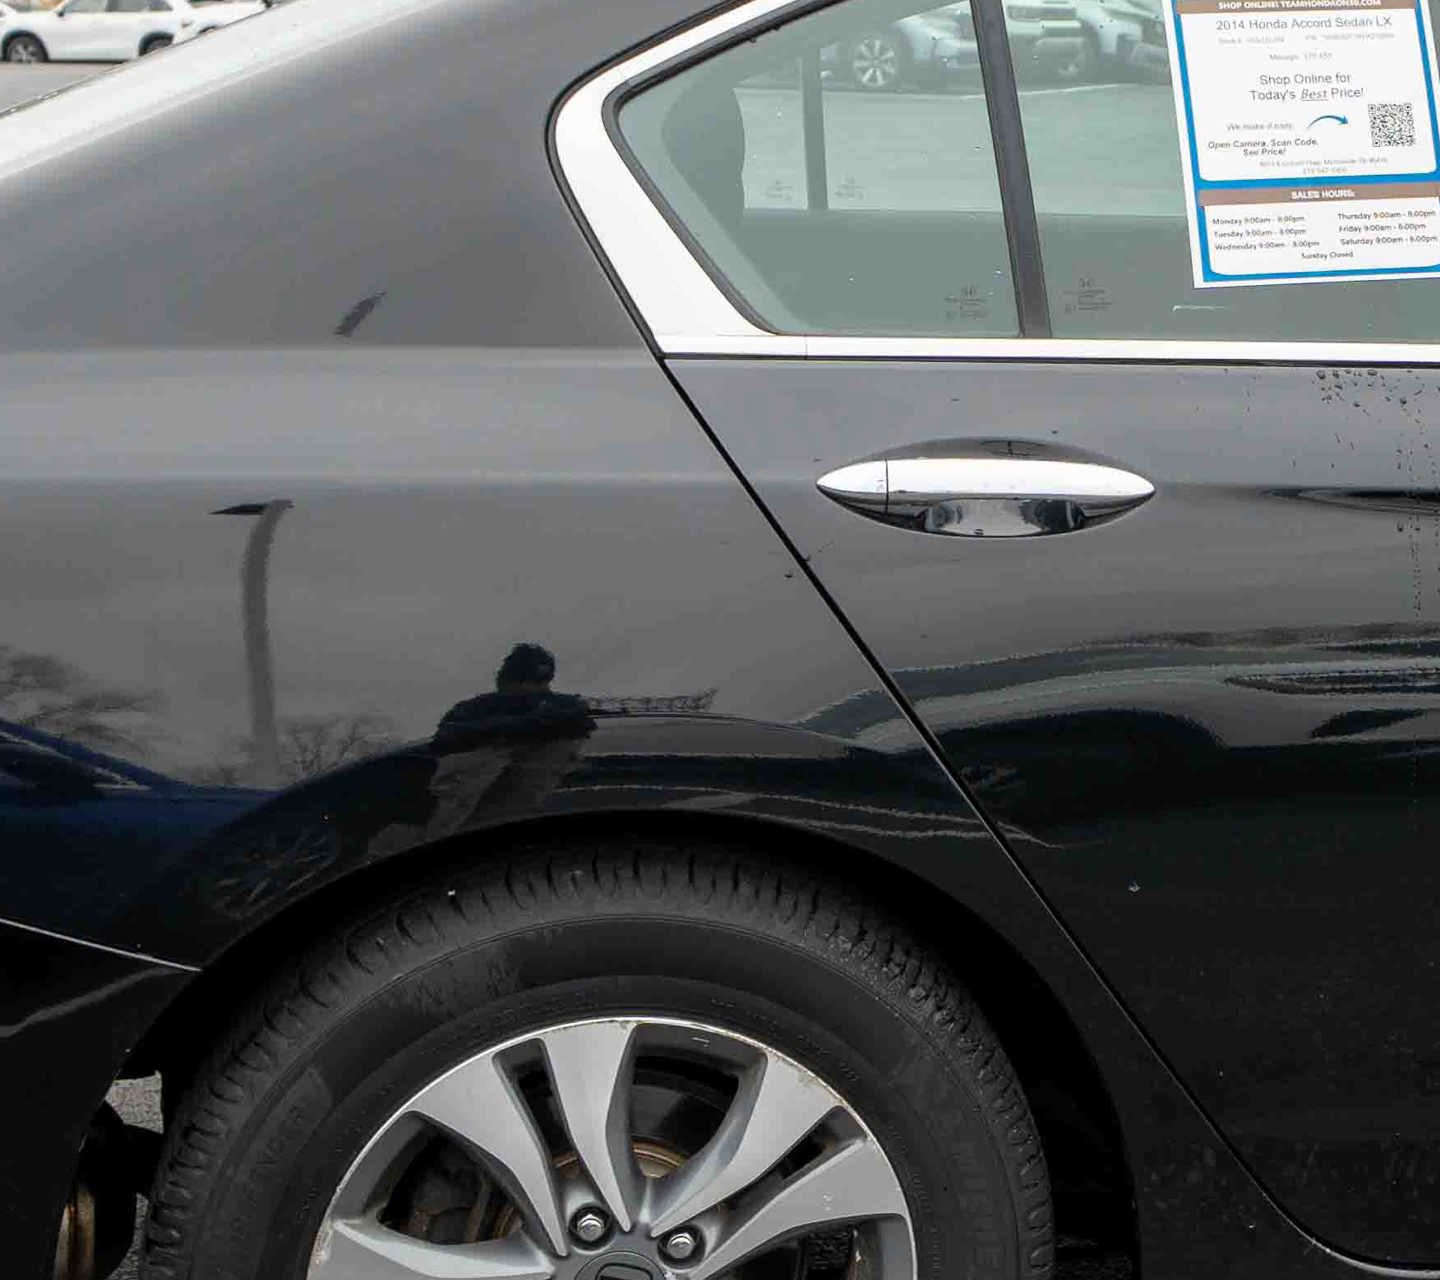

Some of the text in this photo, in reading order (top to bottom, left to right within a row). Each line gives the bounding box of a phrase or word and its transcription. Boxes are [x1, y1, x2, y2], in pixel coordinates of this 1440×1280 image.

[1218, 2, 1242, 10] SHOP
[1216, 16, 1393, 31] 2014 Honda Accord Sedan LX
[1259, 72, 1352, 87] Shop Online for
[1249, 87, 1364, 102] Today's Best Price!
[1208, 140, 1231, 150] Open
[1271, 138, 1292, 147] Scan
[1291, 190, 1320, 200] SALES
[1338, 212, 1371, 221] Thursday
[1212, 218, 1242, 226] Monday
[1214, 230, 1243, 238] Tuesday
[1338, 226, 1362, 234] Friday
[1215, 242, 1257, 251] Wednesday
[1341, 238, 1374, 246] Saturday
